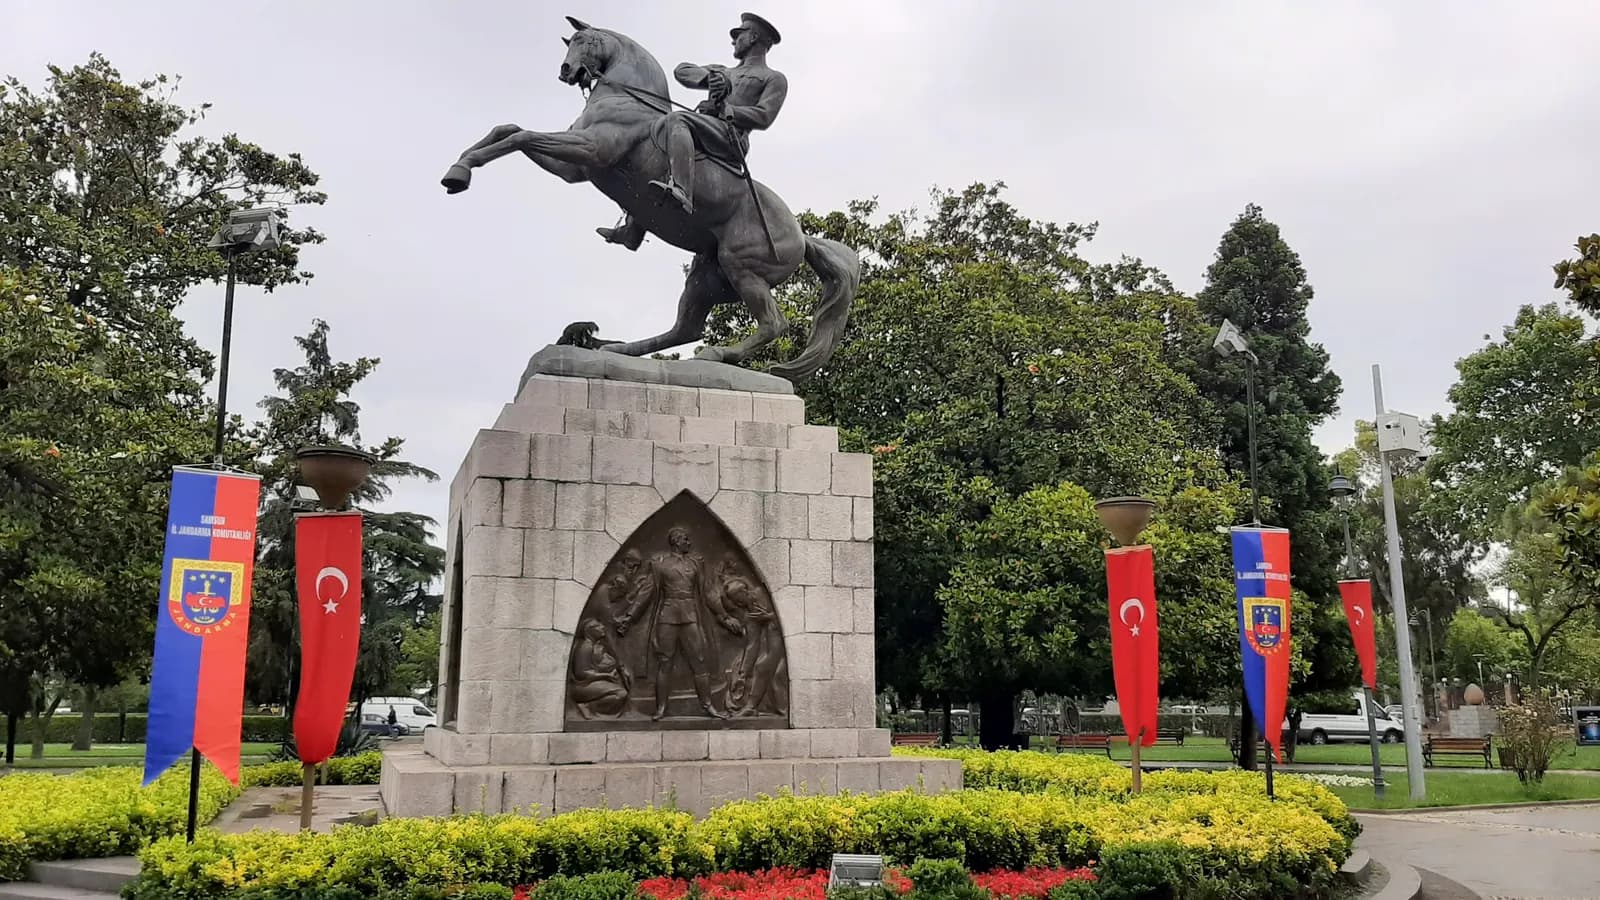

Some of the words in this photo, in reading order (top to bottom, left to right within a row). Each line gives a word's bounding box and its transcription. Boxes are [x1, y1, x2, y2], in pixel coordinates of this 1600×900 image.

[201, 514, 226, 525] SAMSUN
[178, 525, 211, 537] JANDARMA
[173, 609, 236, 634] JANDARMA
